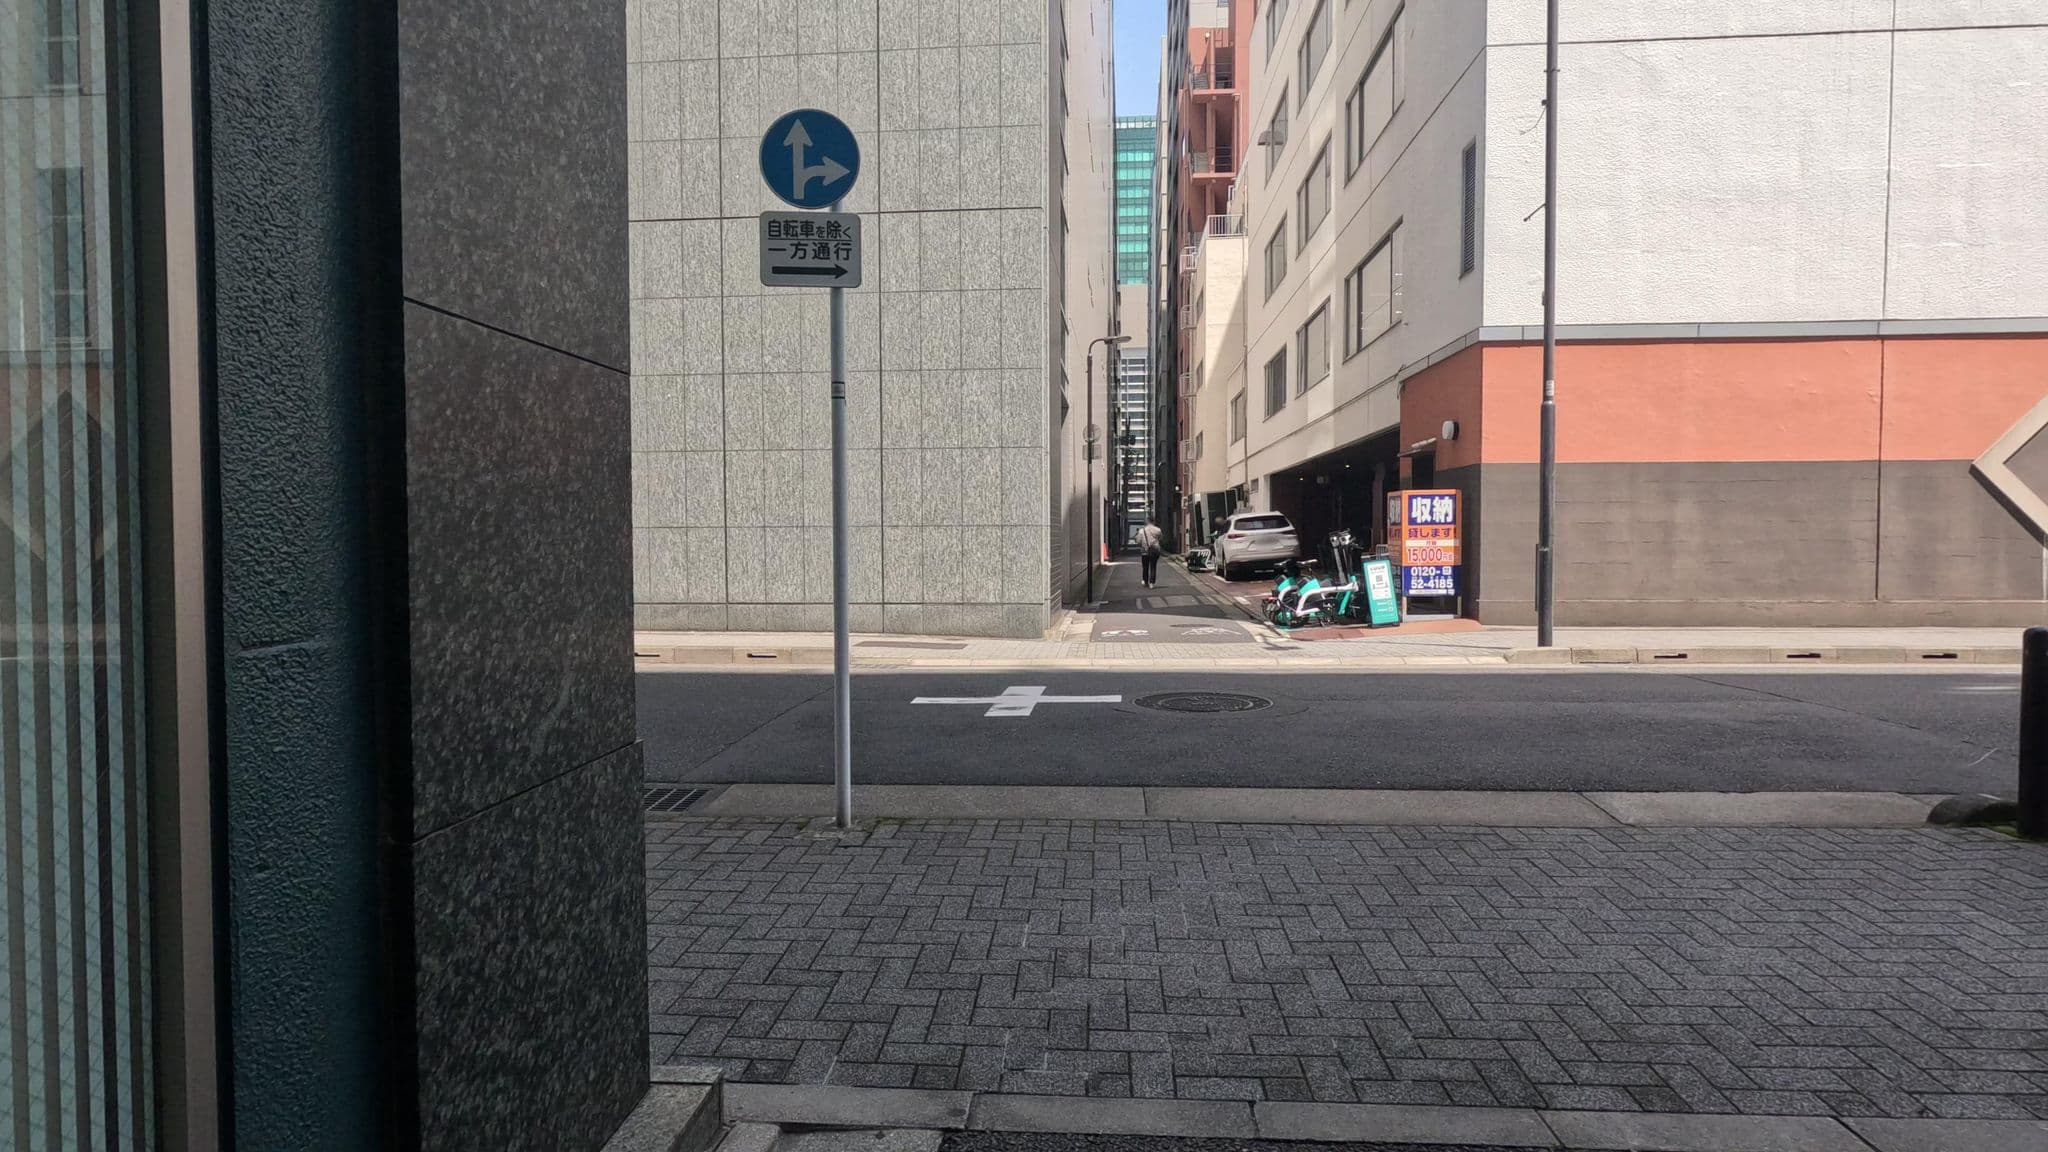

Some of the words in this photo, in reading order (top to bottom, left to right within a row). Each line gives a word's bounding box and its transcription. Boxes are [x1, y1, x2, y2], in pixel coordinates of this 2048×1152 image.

[768, 219, 851, 239] 自転車を除く
[768, 241, 852, 260] 一方通行
[1411, 496, 1453, 523] 収納
[1411, 578, 1454, 589] 52-4185
